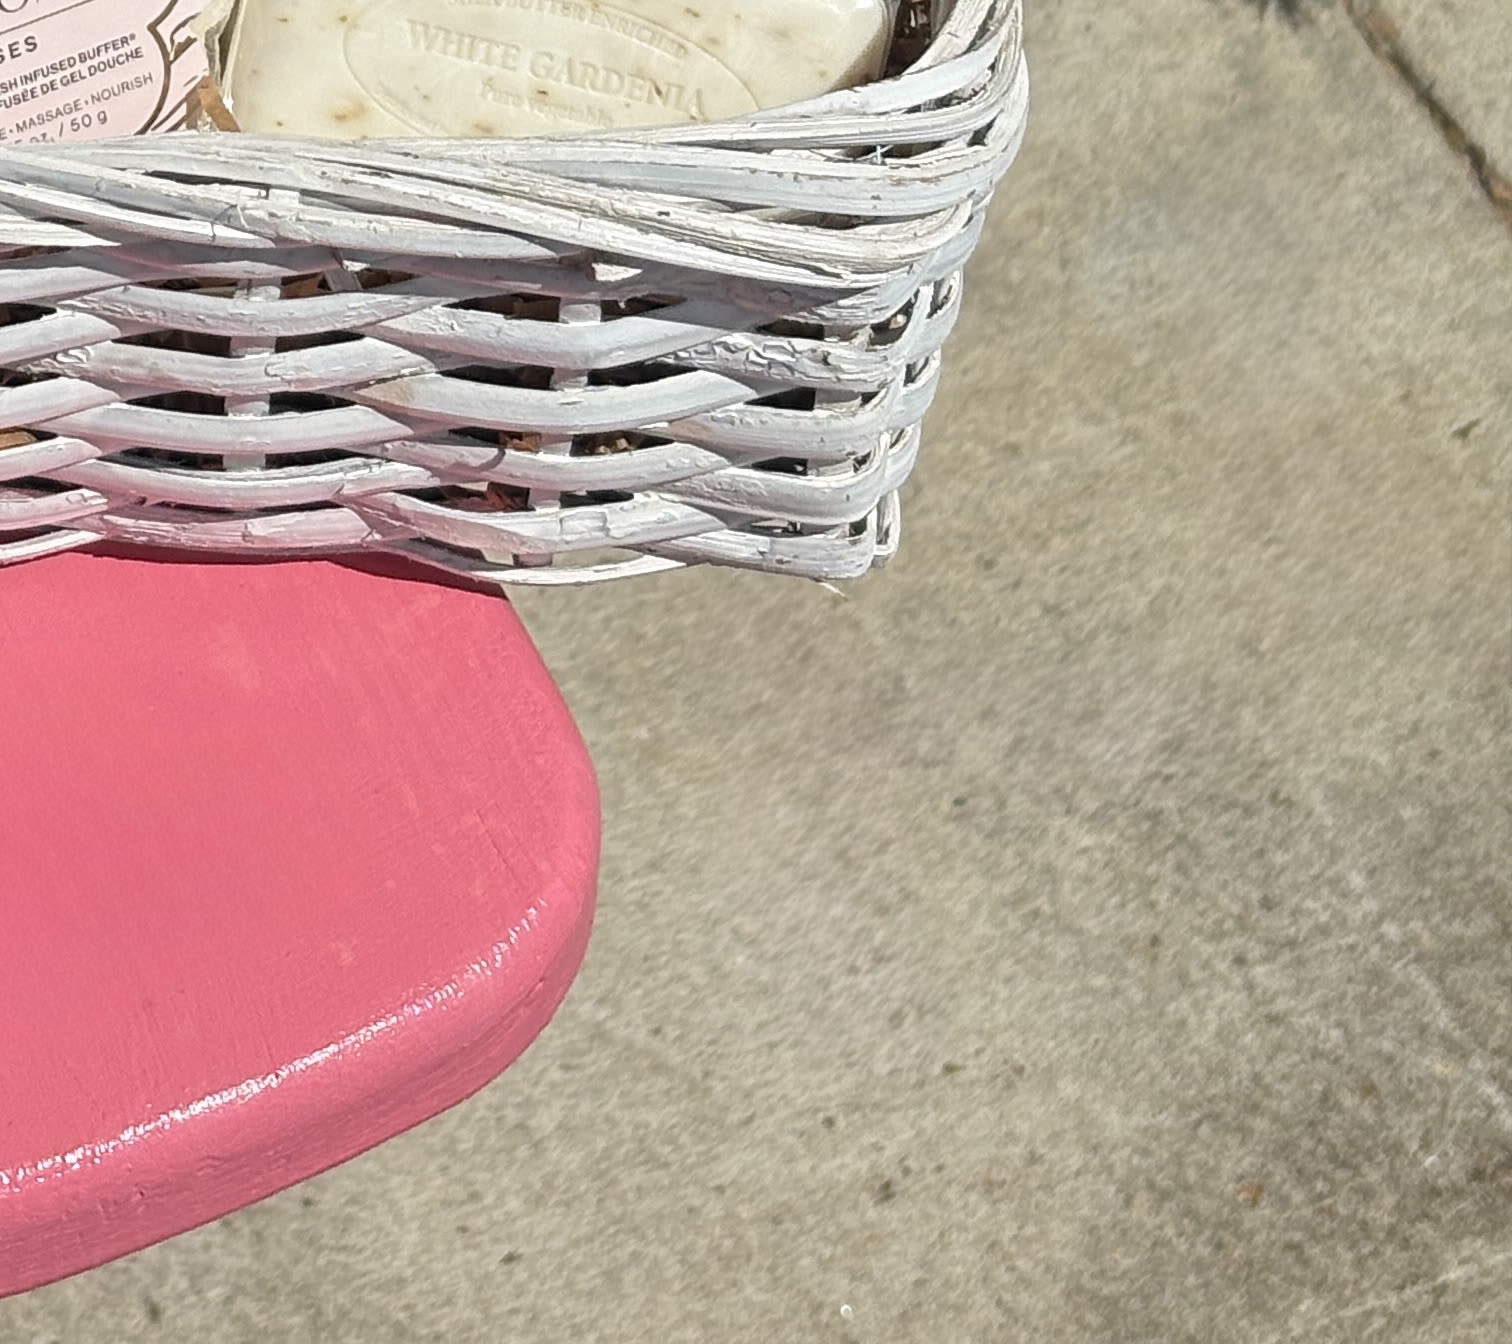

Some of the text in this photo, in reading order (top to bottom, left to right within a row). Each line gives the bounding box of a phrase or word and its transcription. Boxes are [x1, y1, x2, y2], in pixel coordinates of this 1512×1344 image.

[20, 56, 77, 87] INFUSED
[78, 35, 130, 64] BUFFER
[40, 79, 59, 95] DE
[60, 70, 88, 87] GEL
[88, 46, 144, 77] DOUCHE
[406, 18, 705, 120] WHITE GARDENIA
[15, 72, 154, 134] MASSAGE NOURISH
[70, 113, 92, 132] 50
[96, 109, 108, 125] g
